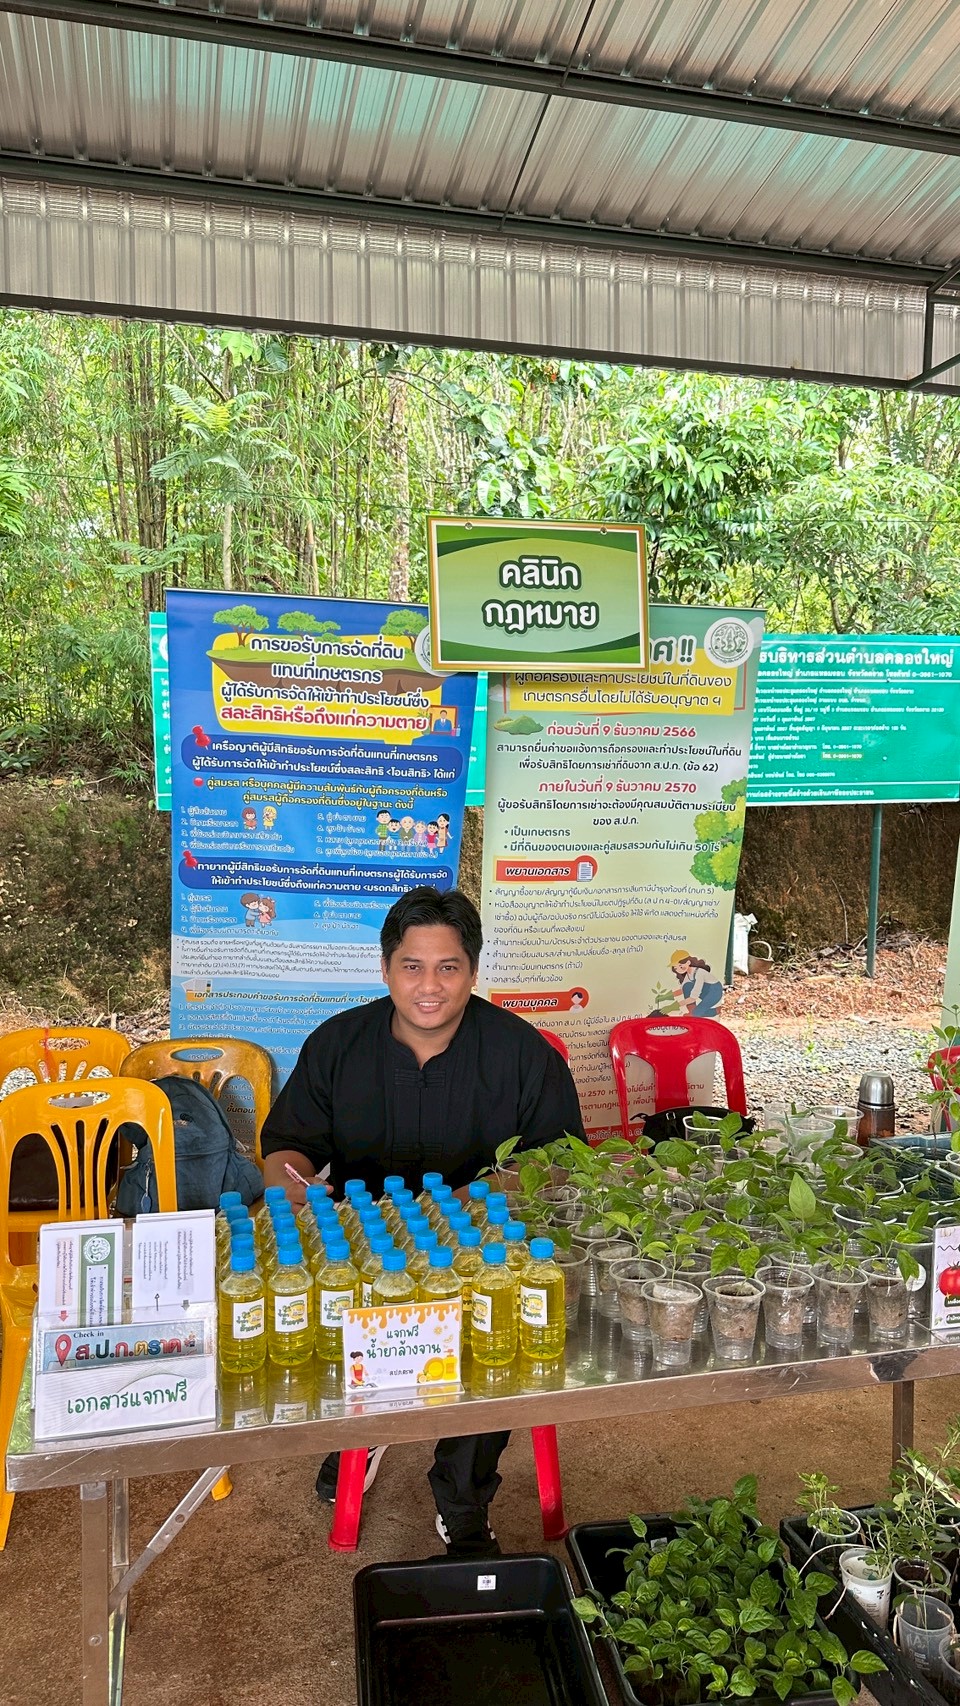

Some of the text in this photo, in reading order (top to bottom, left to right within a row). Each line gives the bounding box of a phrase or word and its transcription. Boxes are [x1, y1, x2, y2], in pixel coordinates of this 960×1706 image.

[500, 556, 580, 588] คลินิก
[483, 601, 598, 632] กฎหมาย
[251, 635, 404, 660] การขอรับการจัดที่ดิน
[759, 646, 954, 668] รบริหารส่วนตำบลคลองใหญ่
[272, 656, 382, 682] แทนที่เกษตรกร
[221, 681, 430, 708] ผู้ได้รับการจัดให้เข้าทำประโยชน์ซึ่ง
[523, 686, 709, 708] เกษตรกรอื่นโดยไม่ได้รับอนุญาต
[221, 705, 428, 730] สละสิทธิหรือถึงแก่ความตาย
[547, 718, 697, 738] ก่อนวันที่ 9 ธันวาคม 2566
[212, 740, 438, 762] เครือญาติผู้มีสิทธิขอรับการจัดที่ดินแทนที่เกษตรกร
[496, 739, 742, 756] สามารถยื่นคำขอแจ้งการถือครองและทำประโยชน์ในที่ดิน
[192, 756, 384, 777] ผู้ได้รับการจัดให้เข้าทำประโยชน์ซึ่งสละสิทธิ
[433, 768, 456, 779] ได้แก่
[519, 755, 719, 773] เพื่อรับสิทธิโดยการเช่าที่ดินจาก ส.ป.ก. (ข้อ 62)
[207, 776, 240, 791] คู่สมรส
[538, 775, 697, 794] ภายในวันที่ 9 ธันวาคม 2570
[497, 798, 736, 813] ผู้ขอรับสิทธิโดยการเช่าจะต้องมีคุณสมบัติตามระเบียบ
[592, 815, 640, 826] ของ ส.ป.ก.
[510, 825, 571, 837] เป็นเกษตรกร
[510, 838, 720, 855] มีที่ดินของตนเองและคู่สมรสรวมกันไม่เกิน 50 ไร่
[197, 861, 448, 882] ทายาทผู้มีสิทธิขอรับการจัดที่ดินแทนที่เกษตรกรผู้ได้รับการจัด
[505, 866, 571, 877] พยานเอกสาร
[211, 876, 361, 892] ให้เข้าทำประโยชน์ซึ่งถึงแก่ความตาย
[502, 998, 558, 1011] พยานบุคคล
[73, 1331, 95, 1339] Check
[386, 1324, 420, 1340] แจกฟรี
[75, 1338, 182, 1361] ส.ป.ก.ตราด
[366, 1338, 442, 1360] น้ำยาล้างจาน
[67, 1378, 188, 1414] เอกสารแจกฟรี
